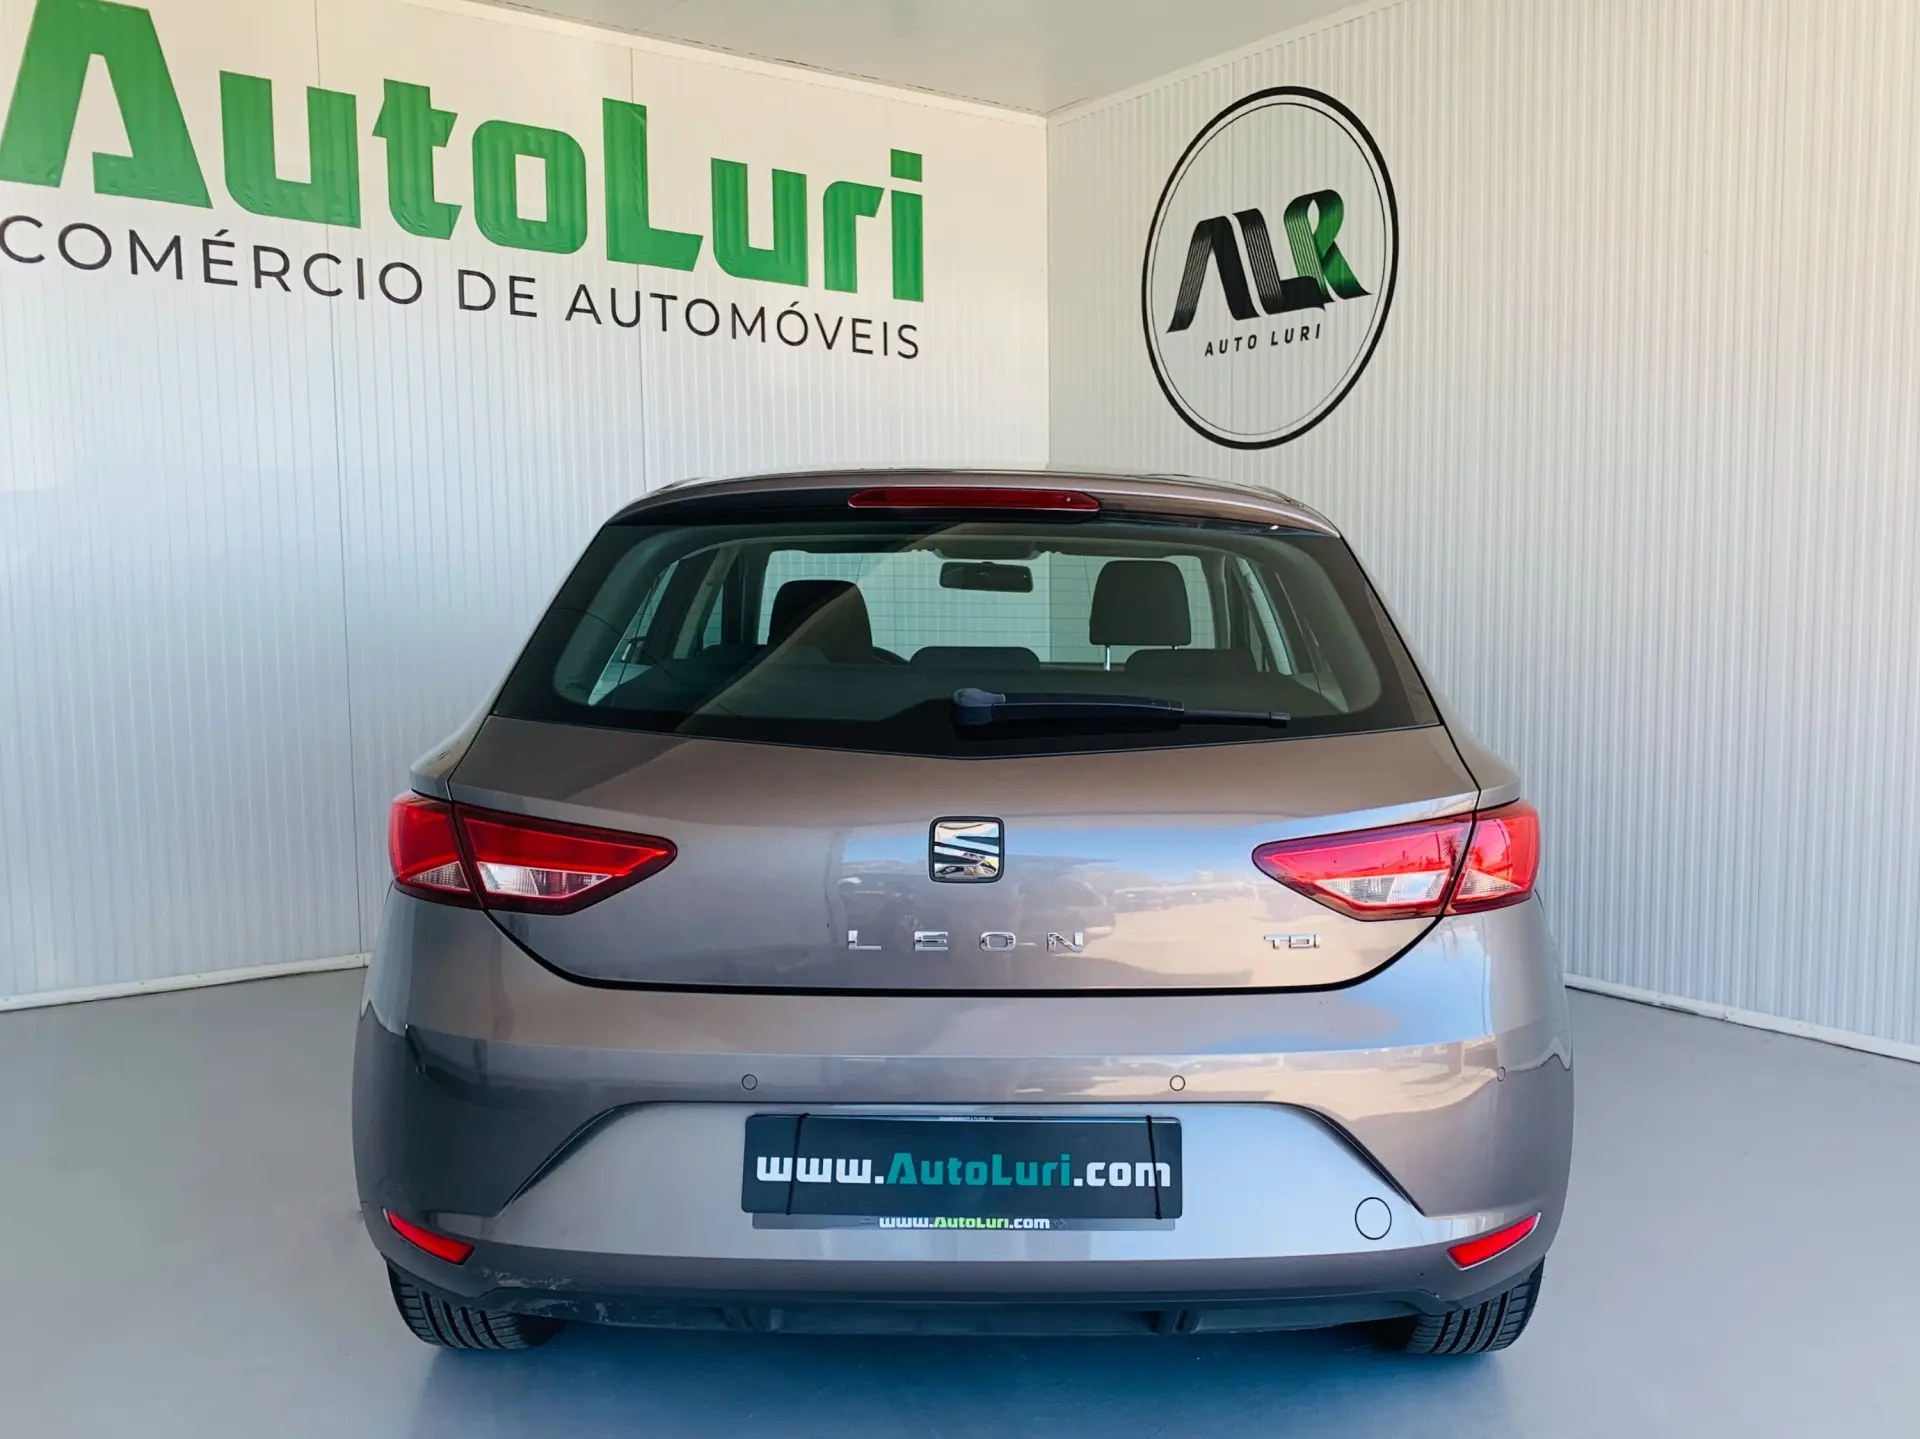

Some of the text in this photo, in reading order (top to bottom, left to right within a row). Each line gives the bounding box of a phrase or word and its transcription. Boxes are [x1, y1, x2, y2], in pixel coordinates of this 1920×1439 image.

[0, 0, 924, 303] AutoLuri
[0, 214, 920, 360] COMÉRCIO DE AUTOMÓVEIS
[1204, 323, 1321, 357] AUTO LURI
[847, 929, 1084, 952] LEON
[1263, 933, 1321, 950] TDI
[756, 1152, 1171, 1187] www.AutoLuri.com
[879, 1216, 1050, 1229] www.AutoLuri.com
